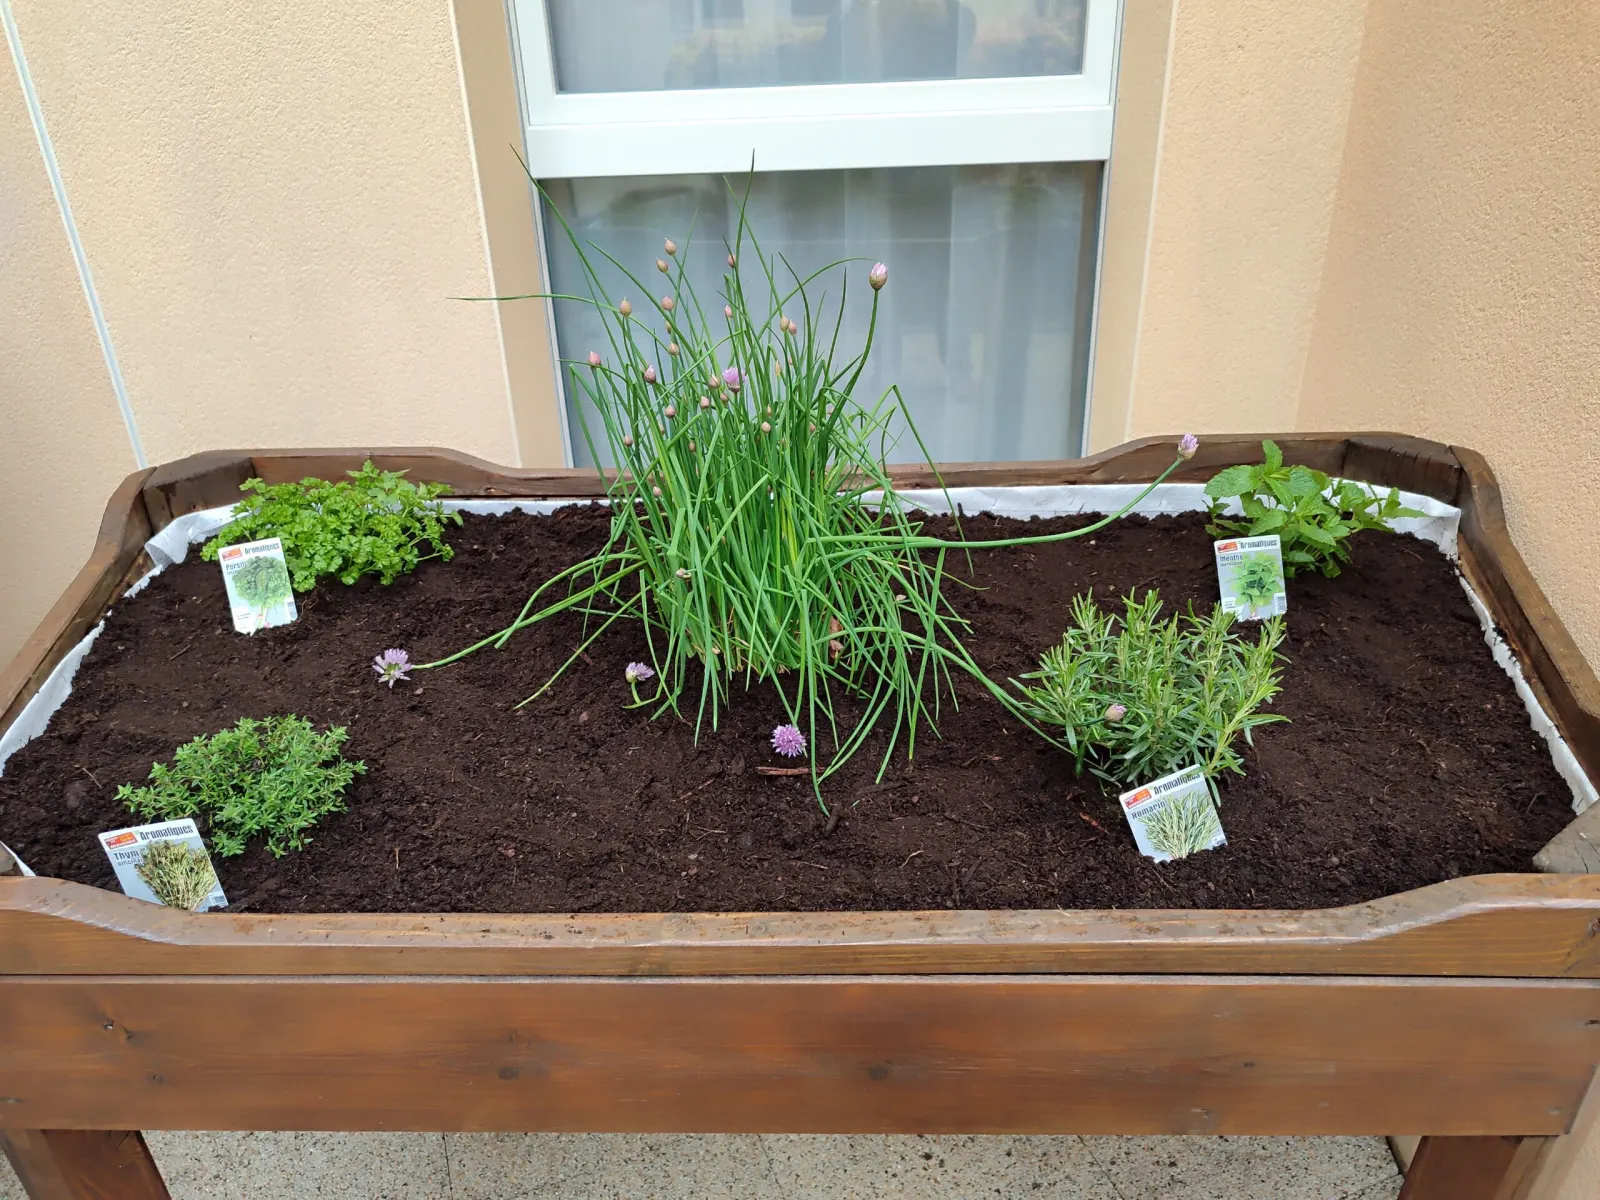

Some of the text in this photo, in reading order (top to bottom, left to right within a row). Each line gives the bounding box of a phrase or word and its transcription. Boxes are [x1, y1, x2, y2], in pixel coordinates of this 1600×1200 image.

[1240, 539, 1278, 550] Aromatiques
[1219, 554, 1244, 562] Menthe
[1131, 800, 1167, 820] Romarin
[139, 824, 194, 842] Aromatiques
[113, 849, 140, 861] Thym
